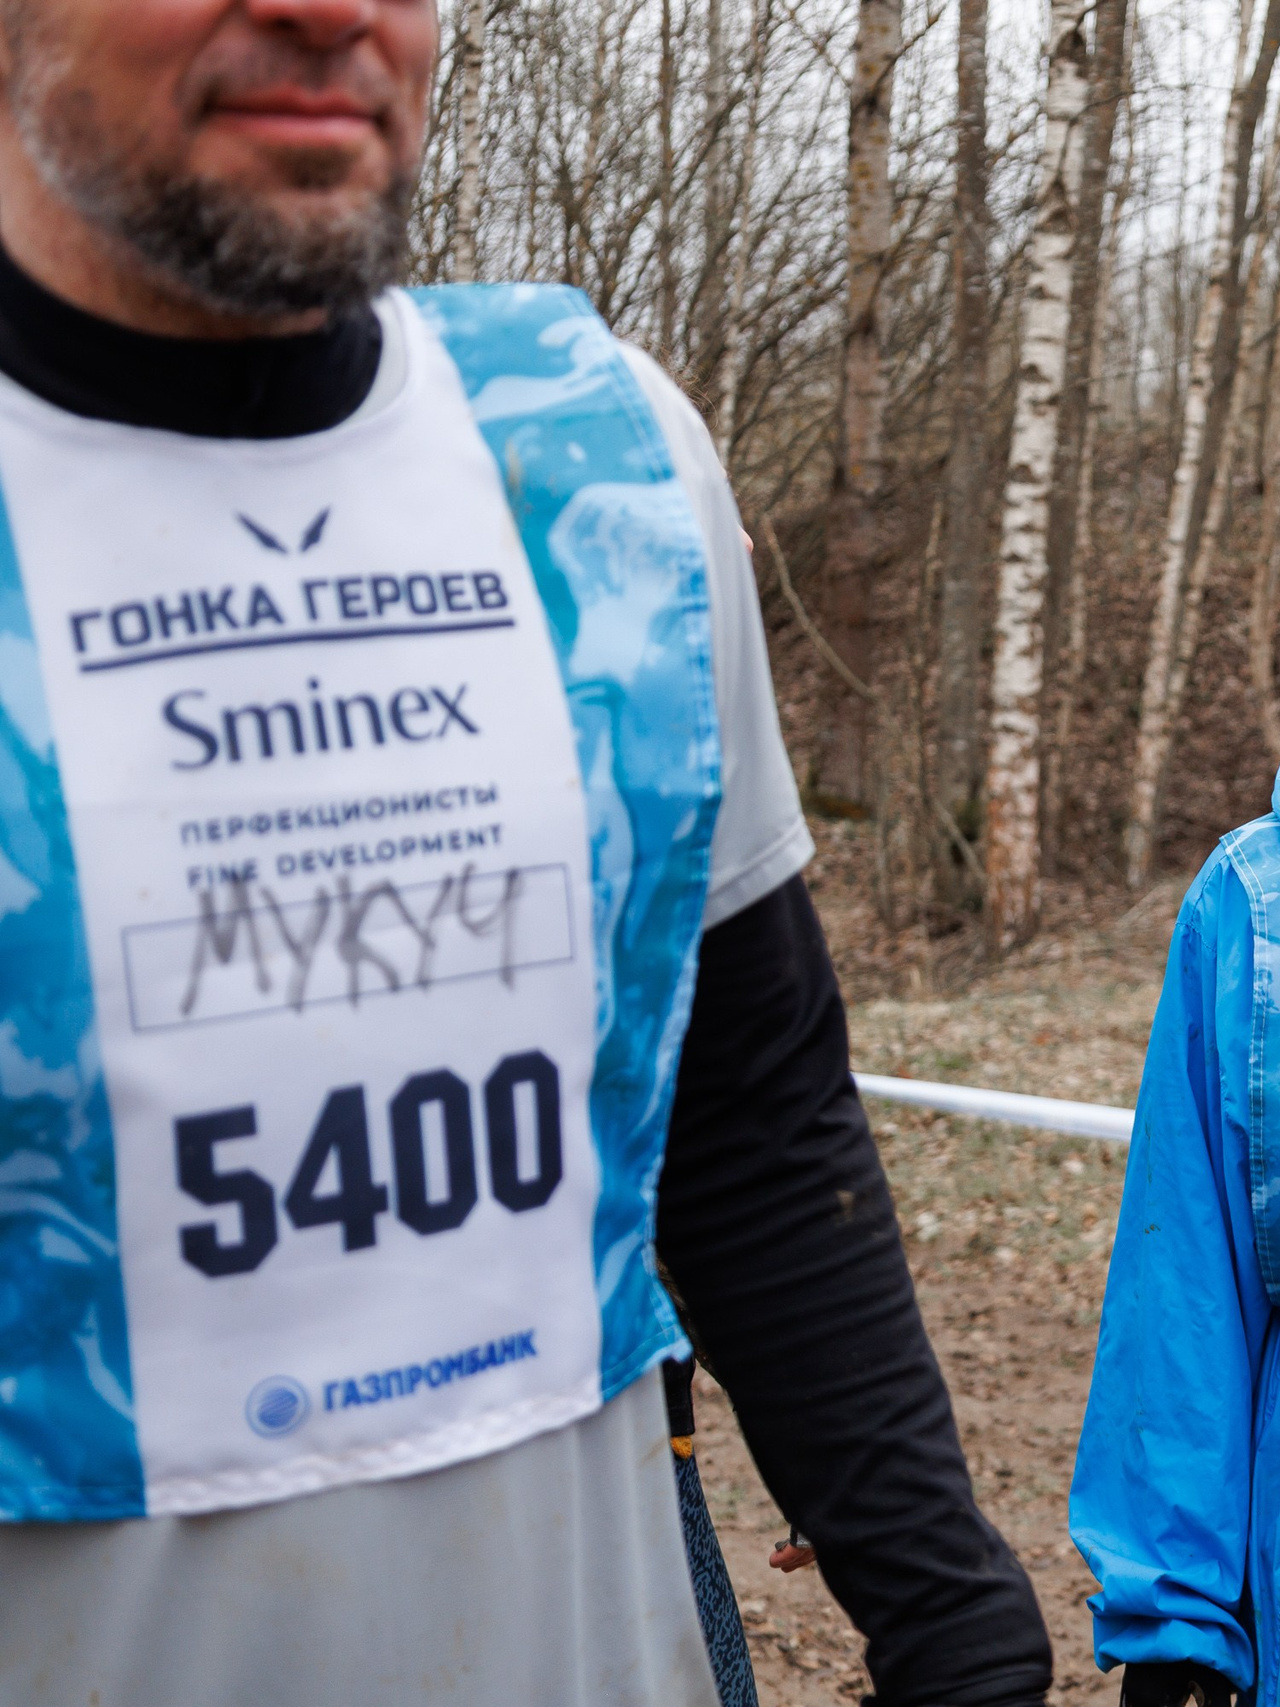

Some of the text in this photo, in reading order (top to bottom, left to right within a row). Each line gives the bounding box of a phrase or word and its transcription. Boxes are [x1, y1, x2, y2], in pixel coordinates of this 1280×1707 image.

[68, 571, 510, 655] ГОНКА ГЕРОЕВ
[161, 677, 480, 771] Sminex
[180, 782, 500, 846] ПЕРФЕКЦИОНИСТЫ
[186, 823, 504, 890] FINE DEVELOPMENT
[172, 1047, 565, 1279] 5400
[321, 1328, 539, 1413] ГАЗПРОМБАНК
